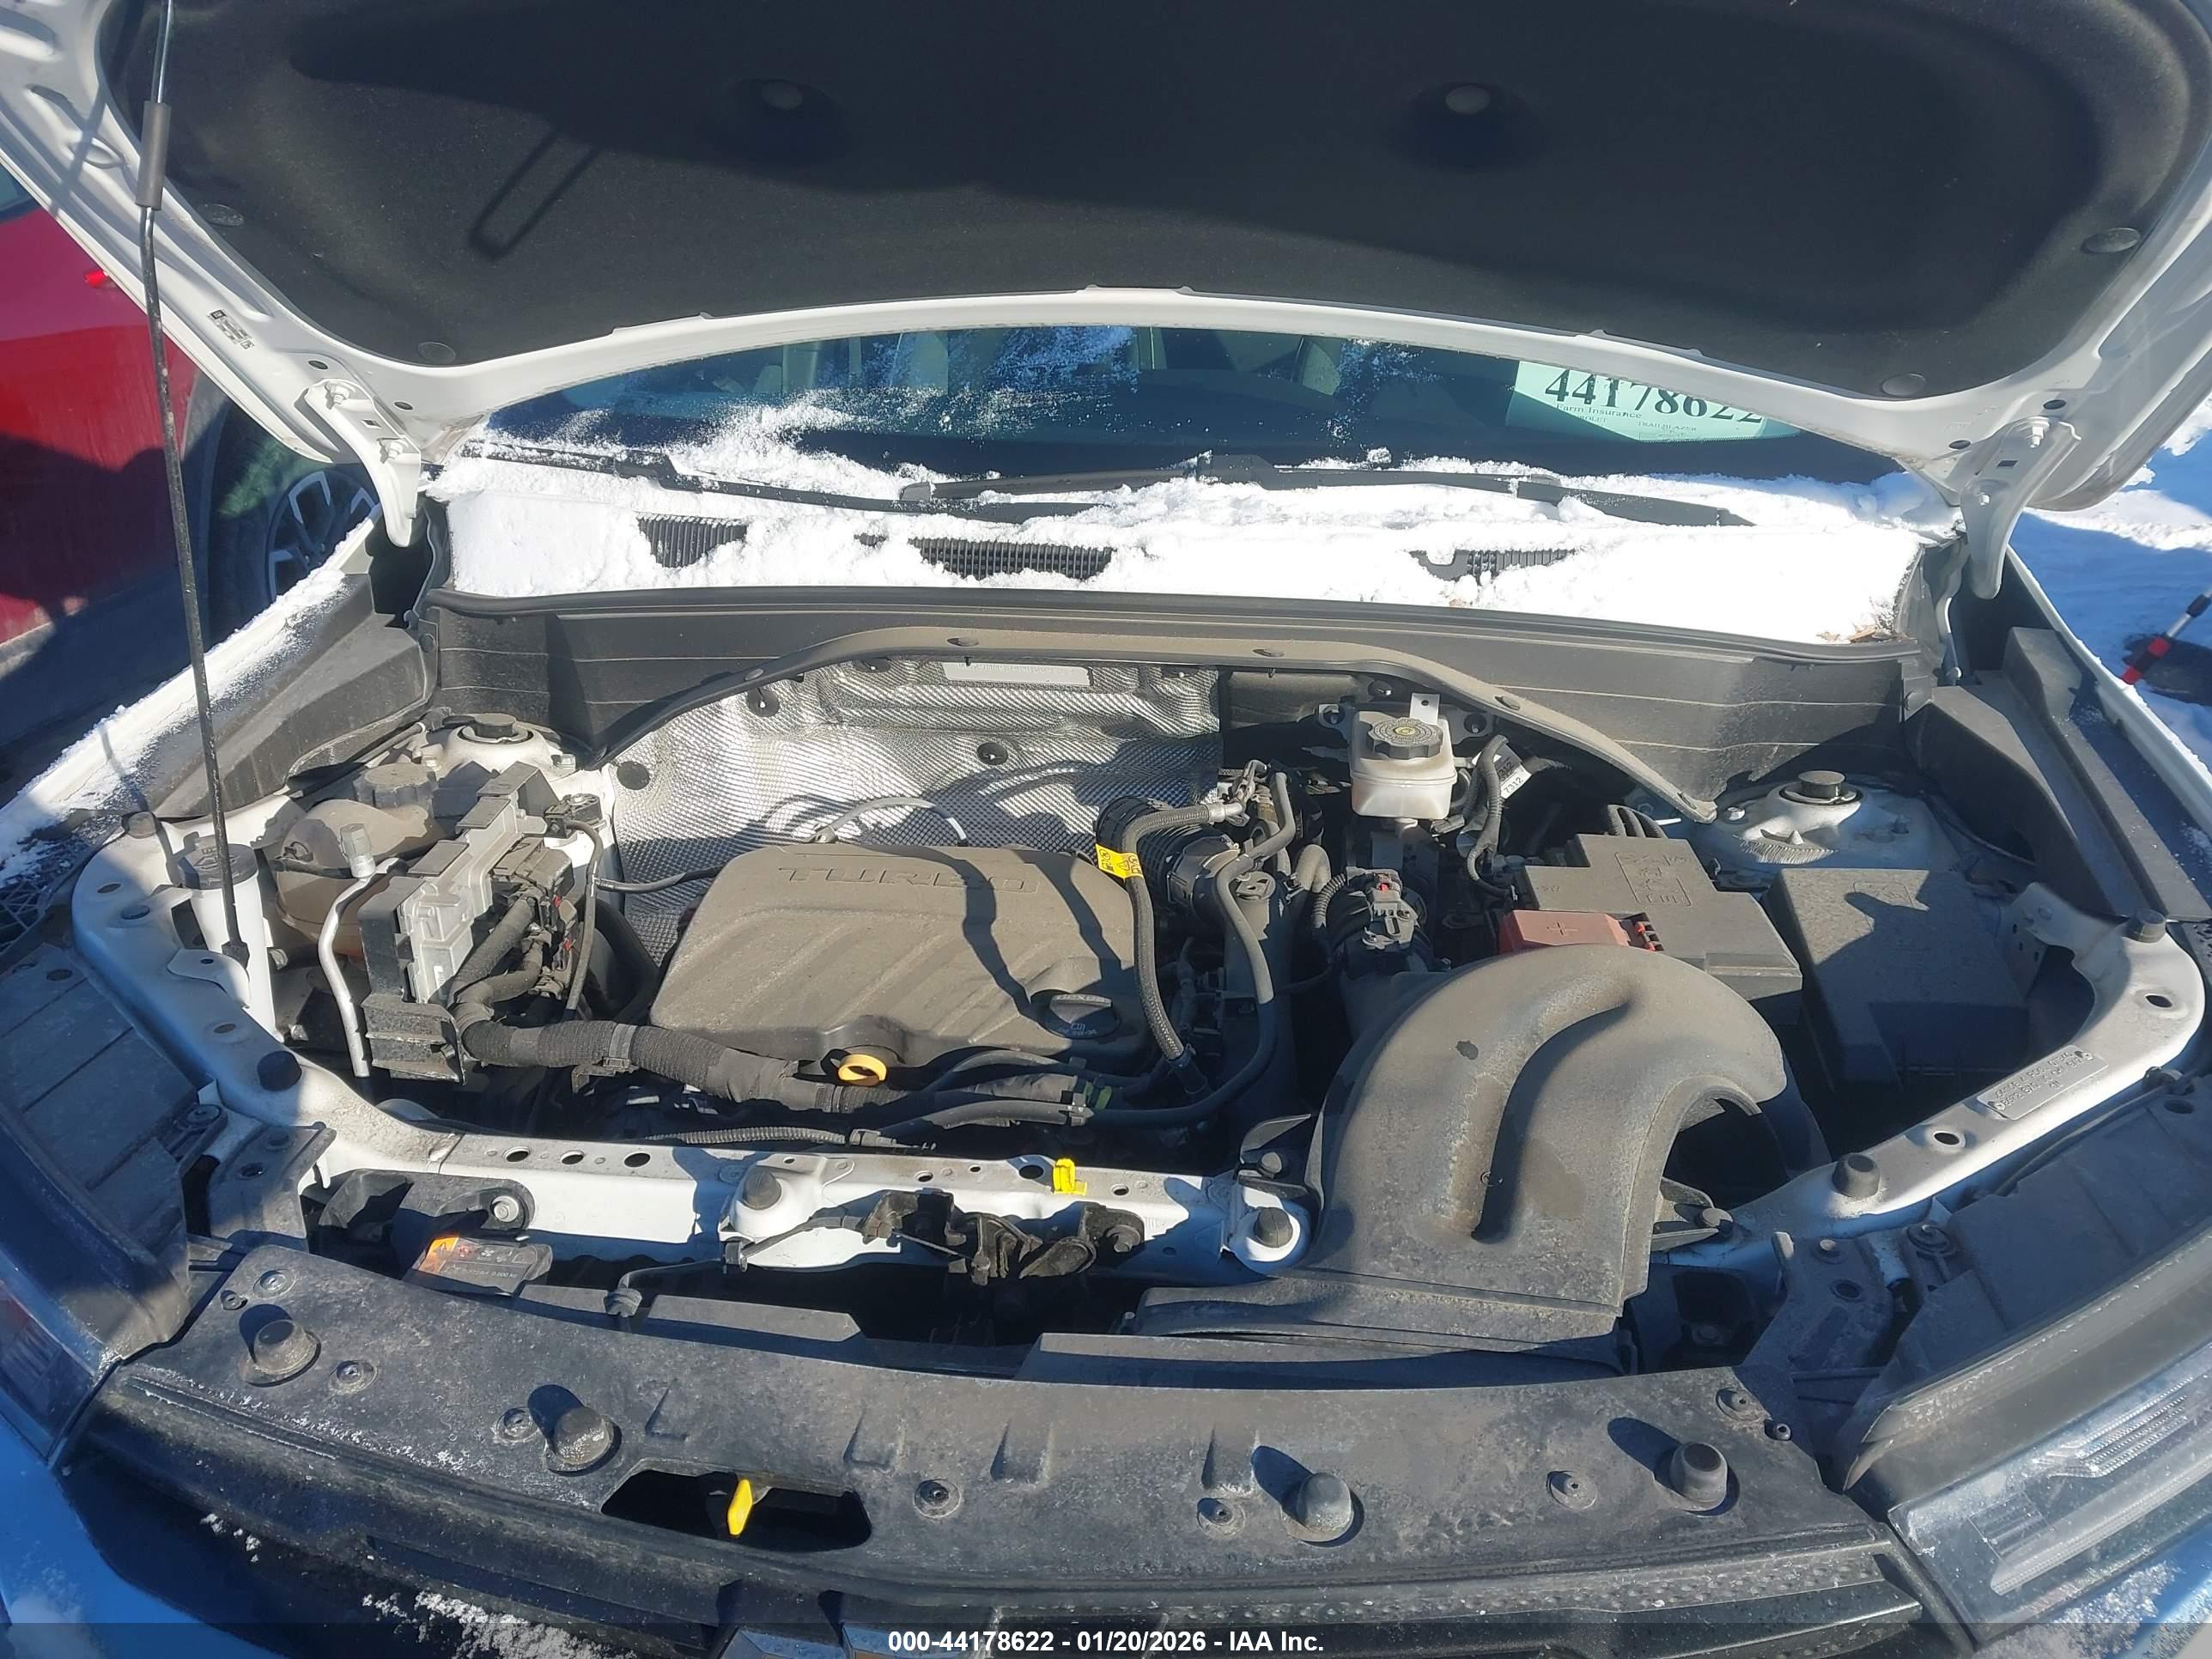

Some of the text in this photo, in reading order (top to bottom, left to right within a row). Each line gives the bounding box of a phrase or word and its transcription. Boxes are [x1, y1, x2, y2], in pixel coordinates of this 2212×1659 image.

[1545, 368, 1763, 424] 441786
[1556, 403, 1643, 419] Farm Insurance
[1503, 775, 1524, 794] 7312
[777, 866, 1041, 895] TURBO
